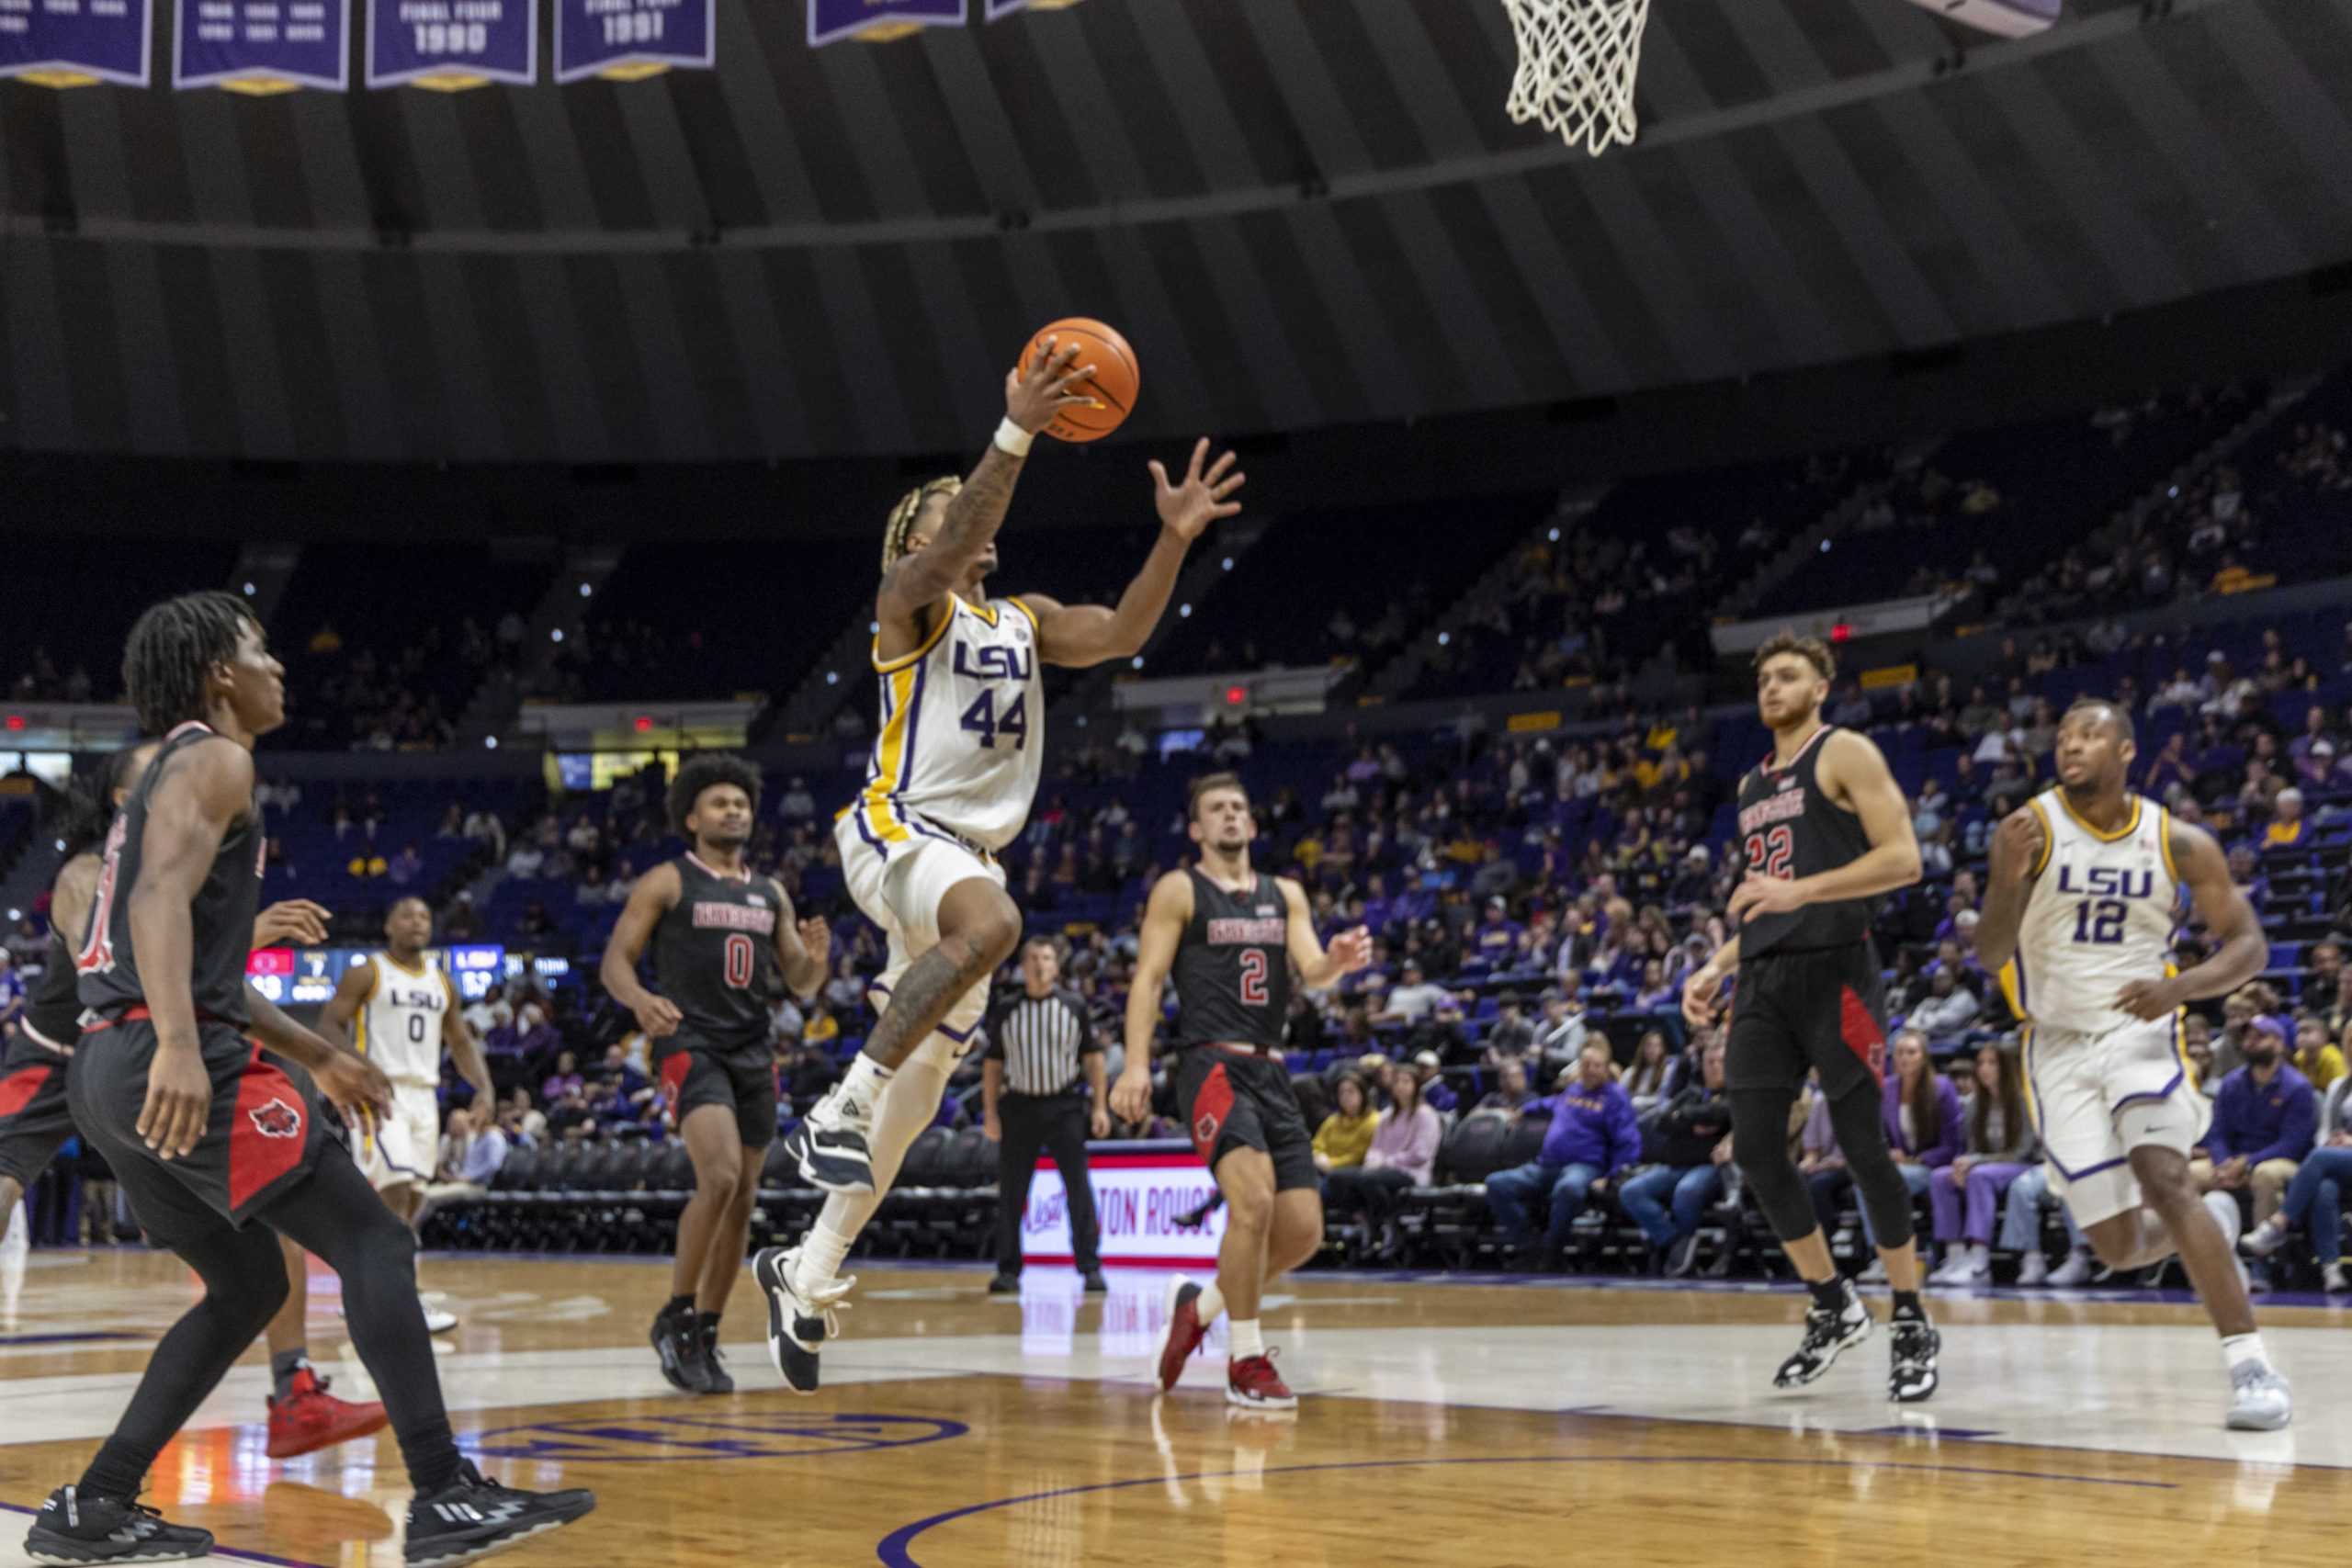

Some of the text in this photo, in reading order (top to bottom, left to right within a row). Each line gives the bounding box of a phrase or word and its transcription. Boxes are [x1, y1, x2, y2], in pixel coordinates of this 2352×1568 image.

[415, 23, 487, 53] 1990
[954, 640, 1032, 681] LSU
[960, 688, 1028, 750] 44
[1745, 824, 1794, 882] 22
[2057, 864, 2154, 898] LSU
[2073, 900, 2129, 943] 12
[724, 932, 755, 989] 0
[1238, 948, 1269, 1007] 2
[390, 989, 443, 1011] LSU
[408, 1013, 425, 1043] 0
[1099, 1188, 1139, 1235] TON
